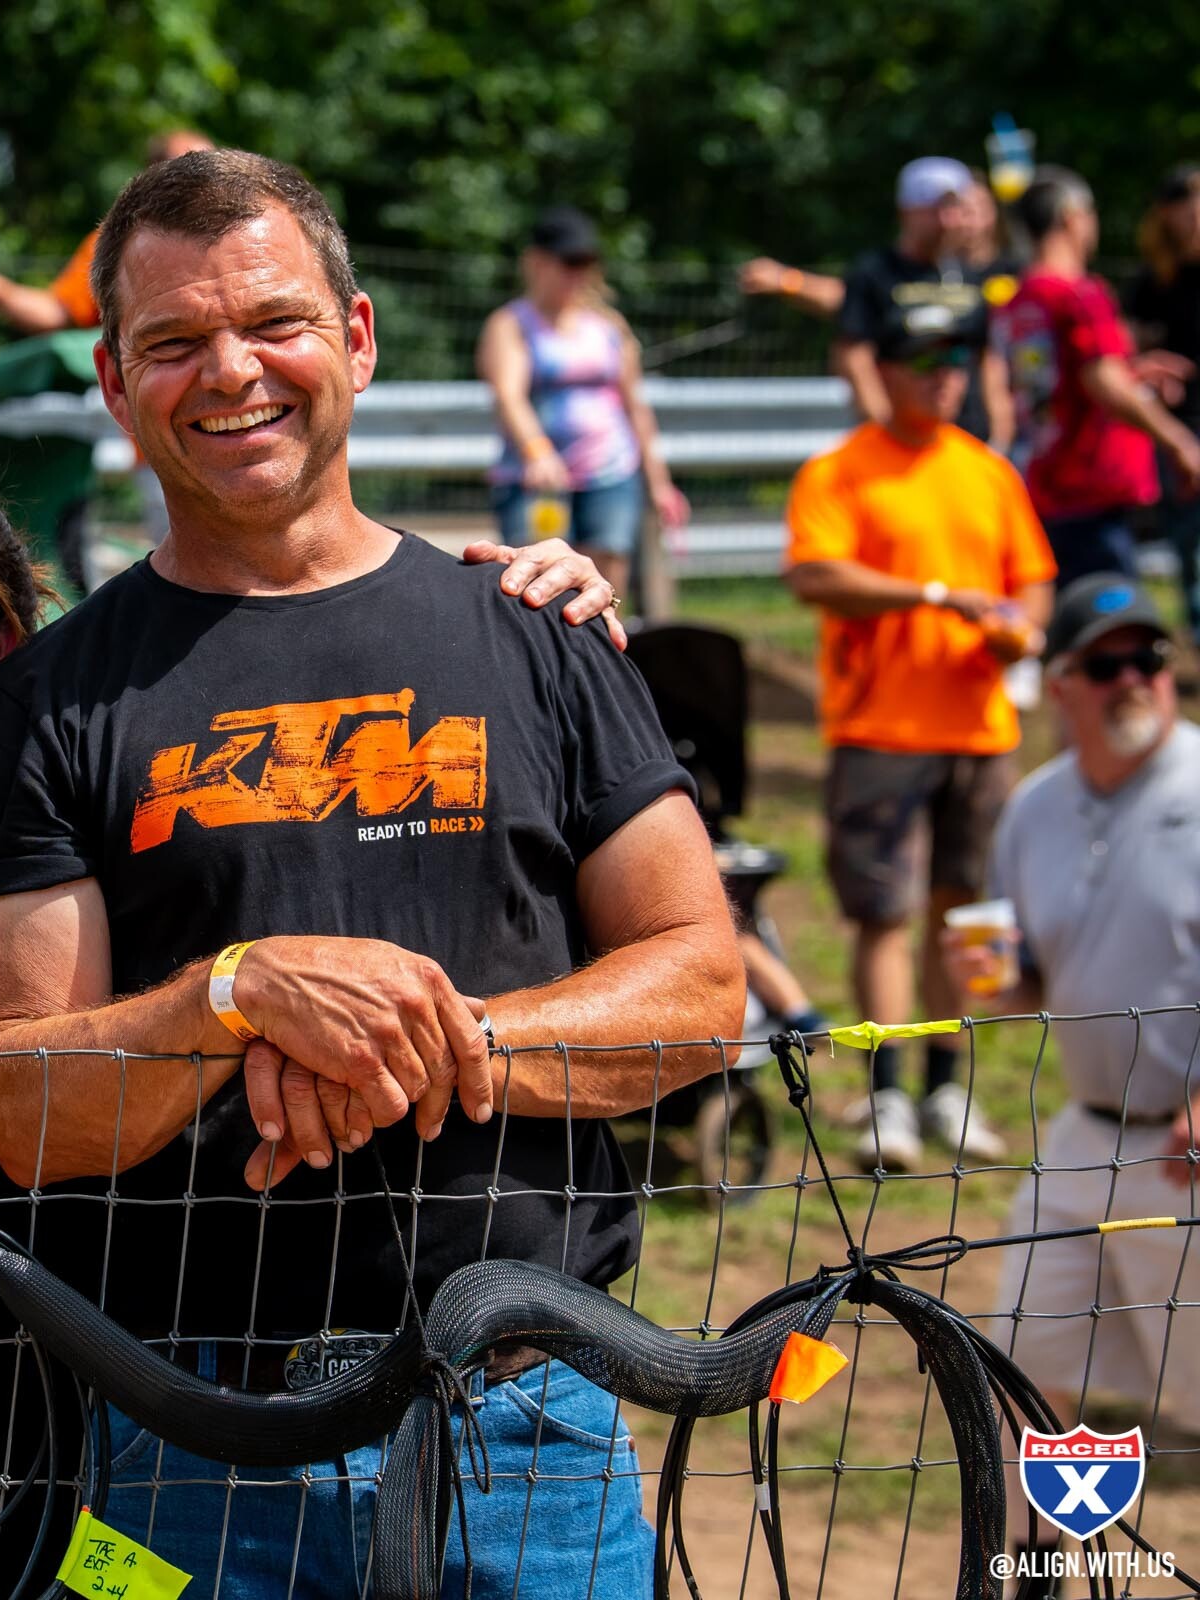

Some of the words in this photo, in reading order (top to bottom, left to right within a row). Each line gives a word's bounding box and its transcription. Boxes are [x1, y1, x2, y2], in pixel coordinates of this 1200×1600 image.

[130, 688, 487, 855] KTM
[357, 823, 404, 842] READY
[407, 820, 427, 837] TO
[430, 817, 468, 834] RACE
